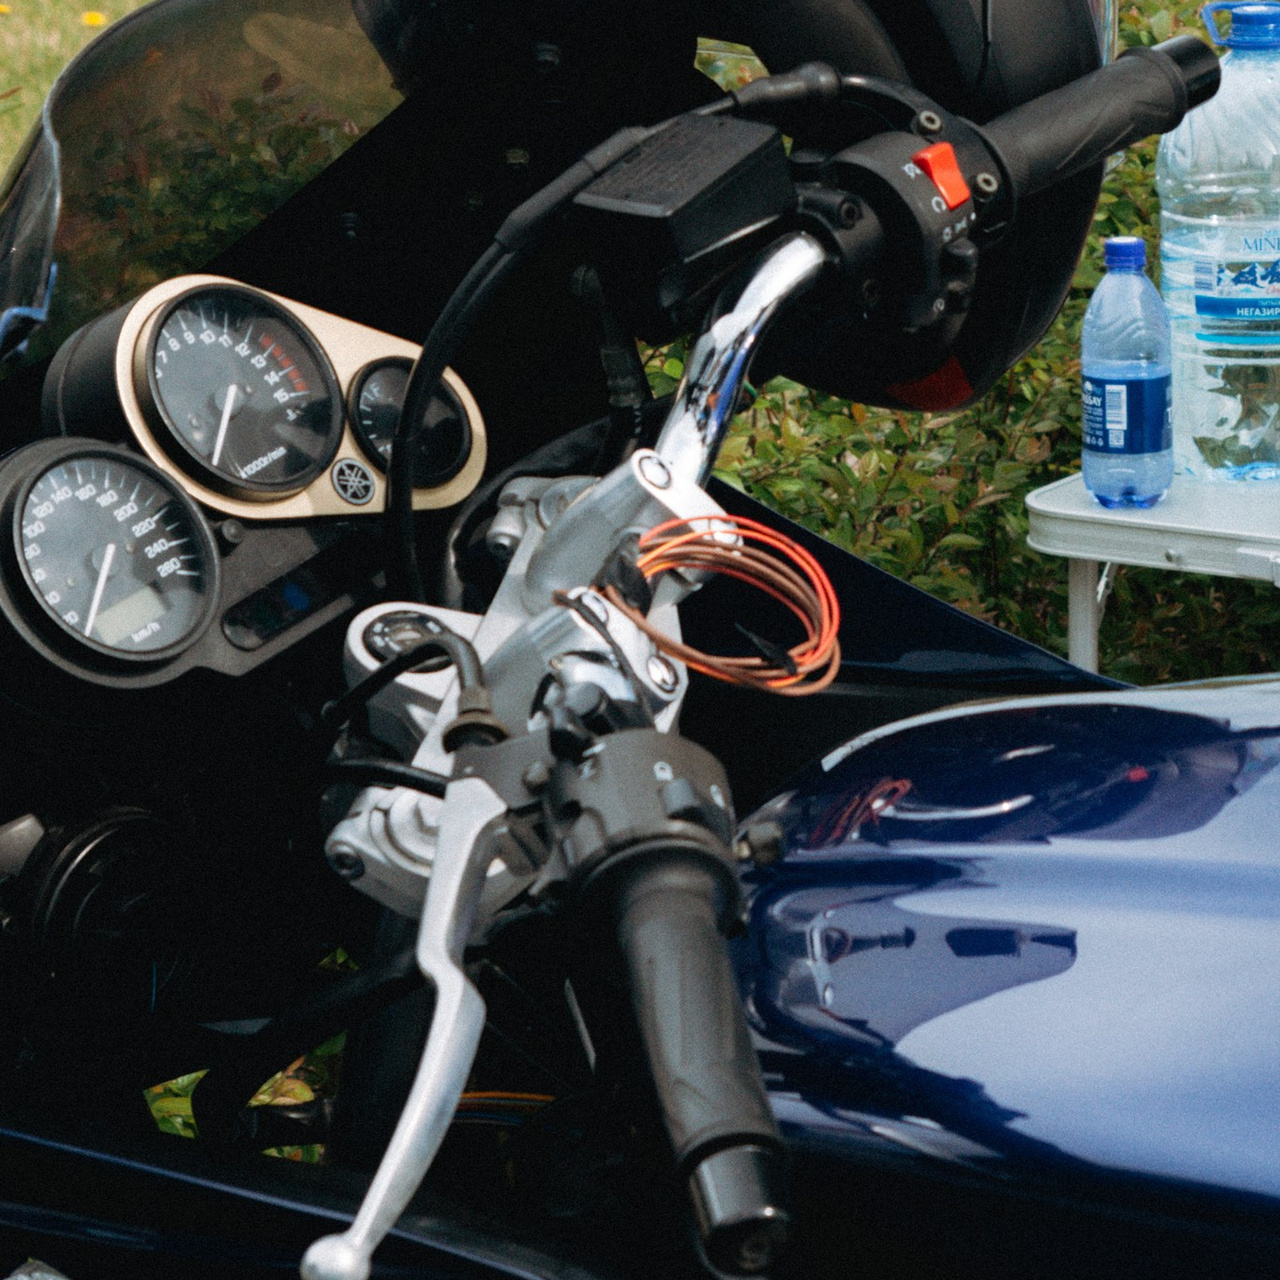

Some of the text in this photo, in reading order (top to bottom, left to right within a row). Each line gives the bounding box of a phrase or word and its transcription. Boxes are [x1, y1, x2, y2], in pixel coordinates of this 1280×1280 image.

[168, 337, 181, 351] 8
[183, 331, 196, 344] 9
[199, 329, 216, 345] 10
[218, 334, 233, 348] 11
[157, 349, 168, 364] 7
[235, 342, 250, 357] 12
[251, 354, 266, 370] 13
[264, 371, 280, 386] 14
[273, 388, 289, 404] 15
[50, 485, 73, 504] 140
[32, 500, 54, 519] 120
[113, 501, 138, 522] 200
[131, 517, 156, 538] 220
[144, 538, 169, 559] 240
